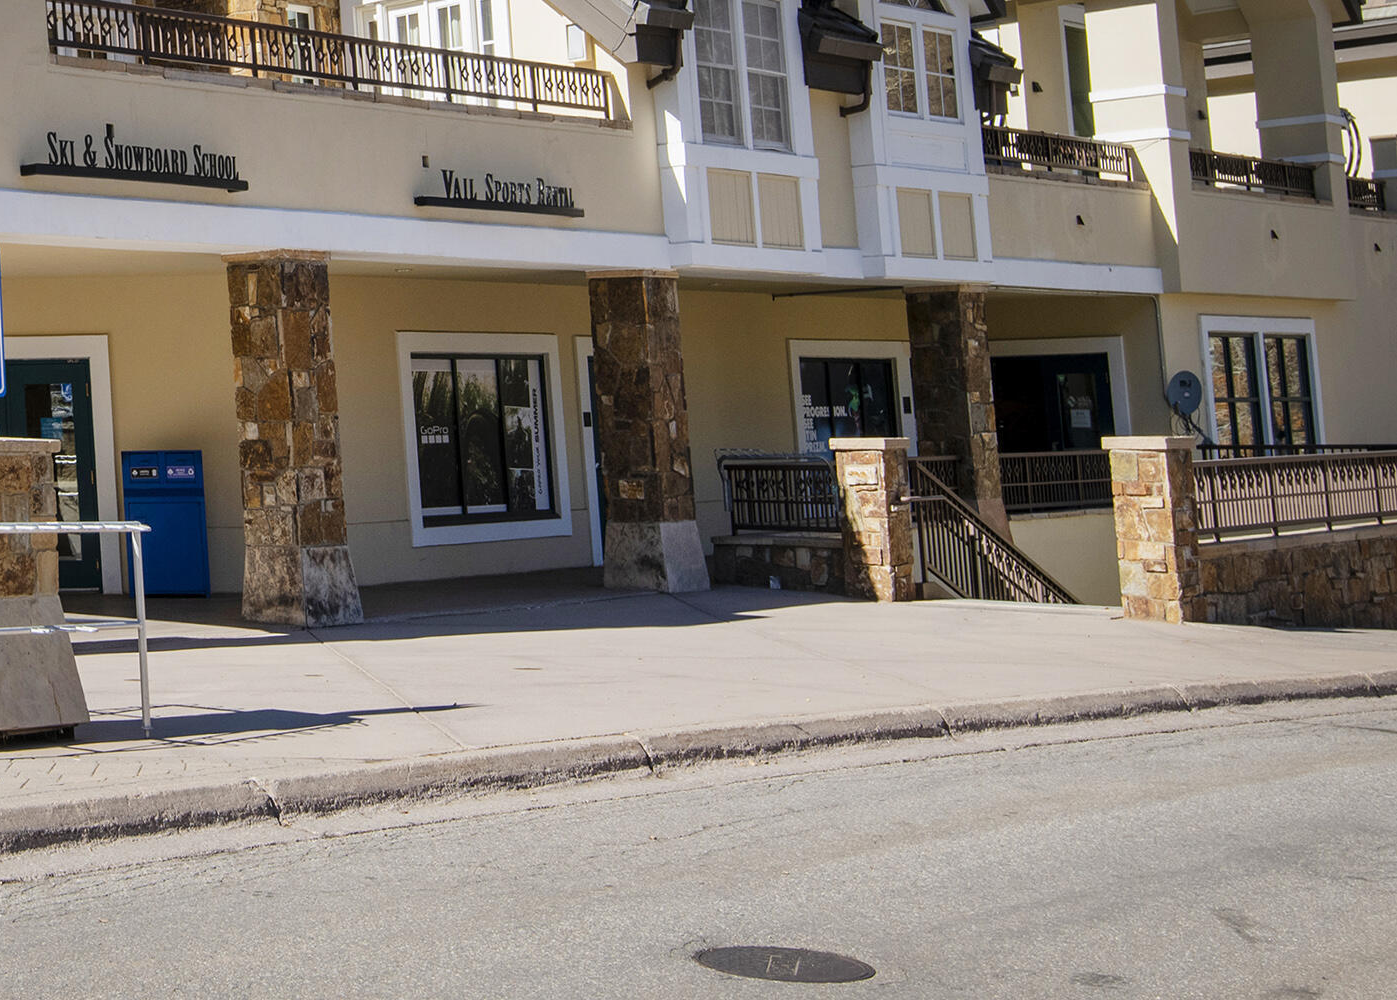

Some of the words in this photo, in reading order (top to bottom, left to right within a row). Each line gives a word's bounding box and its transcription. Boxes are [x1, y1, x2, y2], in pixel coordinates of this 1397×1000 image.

[83, 134, 98, 168] &
[104, 136, 188, 176] SNOWBOARD
[193, 144, 239, 181] SCHOOL
[441, 168, 478, 200] VAIL
[485, 173, 533, 205] SPORTS
[420, 425, 449, 435] GoPro
[532, 388, 540, 443] SUMMER
